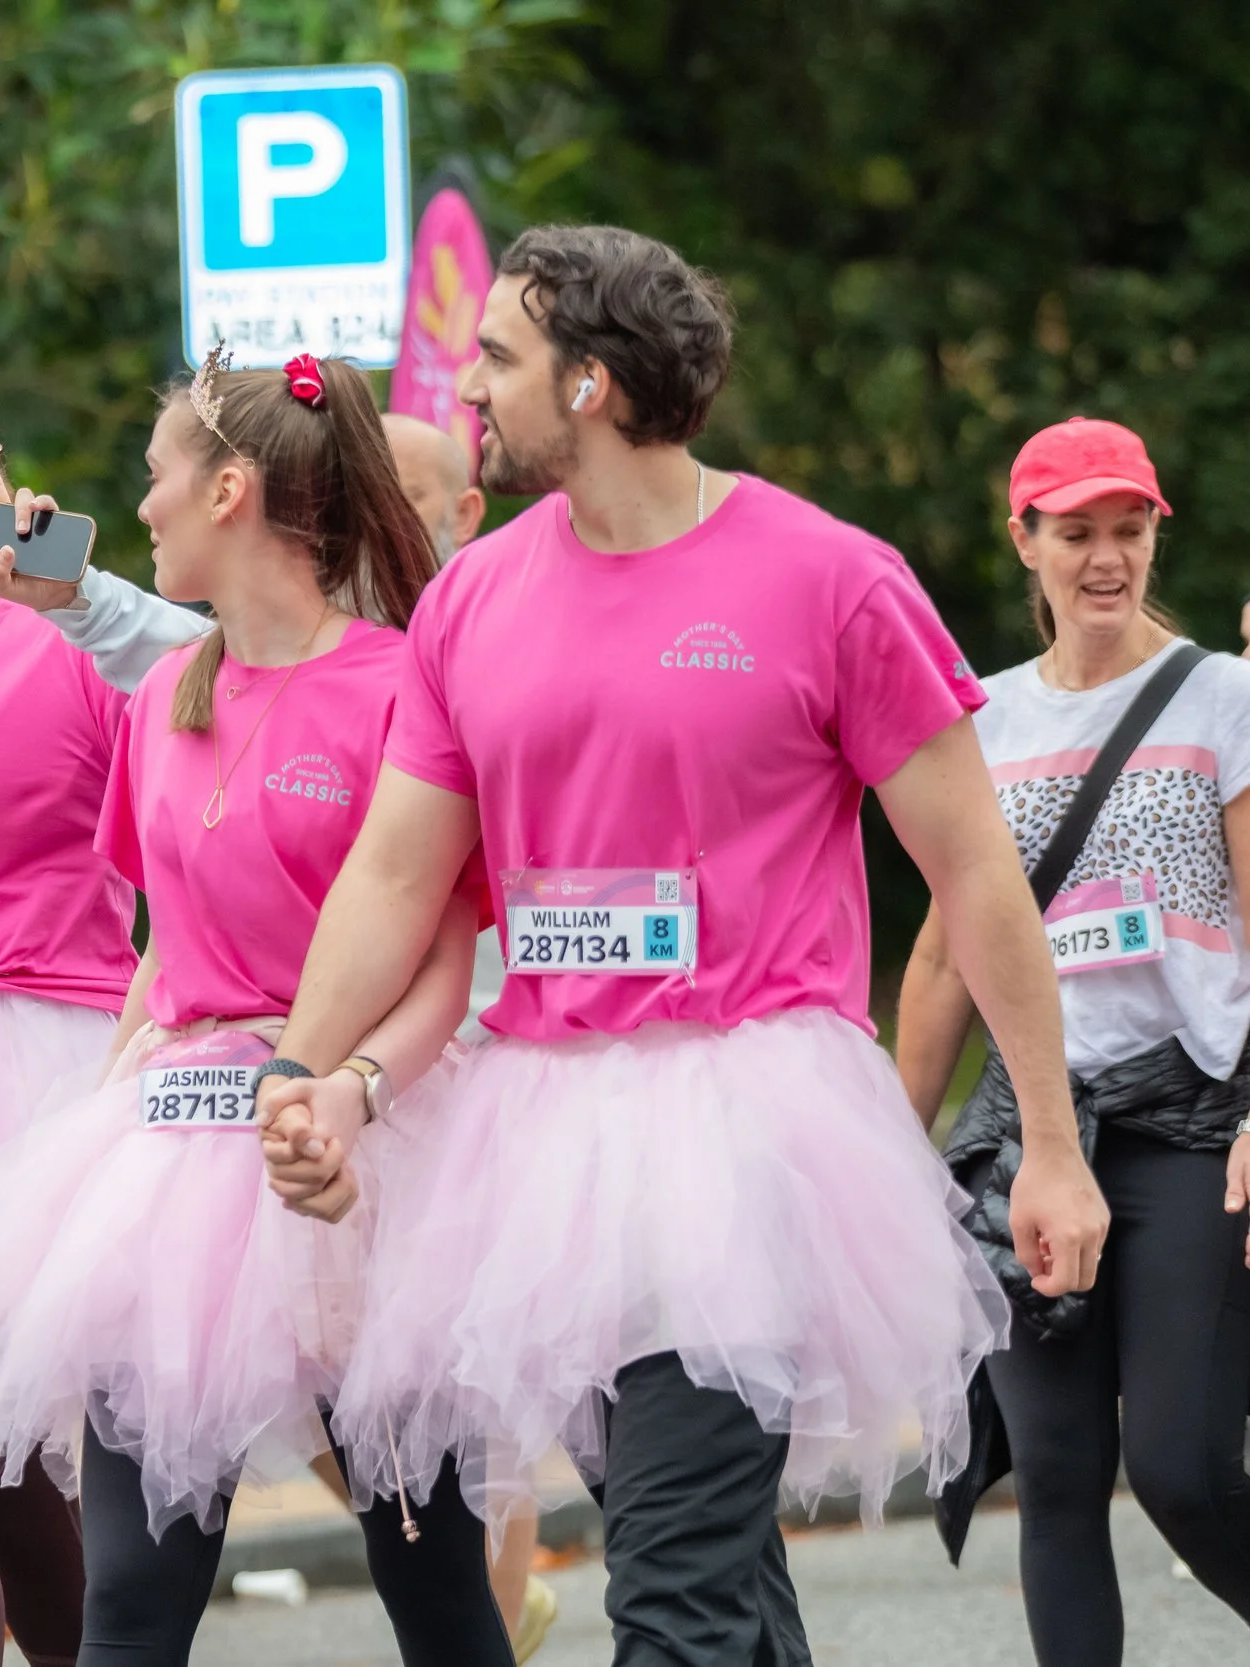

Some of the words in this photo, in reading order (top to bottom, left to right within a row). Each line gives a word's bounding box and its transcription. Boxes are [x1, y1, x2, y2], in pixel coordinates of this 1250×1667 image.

[237, 110, 349, 248] P
[207, 315, 306, 347] AREA
[660, 651, 755, 672] CLASSIC
[281, 754, 331, 774] MOTHER'S
[265, 774, 351, 806] CLASSIC
[531, 910, 611, 928] WILLIAM
[652, 918, 669, 939] 8
[1124, 915, 1140, 933] 8
[518, 934, 631, 963] 287134
[649, 944, 673, 957] KM
[1123, 934, 1145, 948] KM
[159, 1070, 247, 1088] JASMINE
[147, 1092, 257, 1123] 287137
